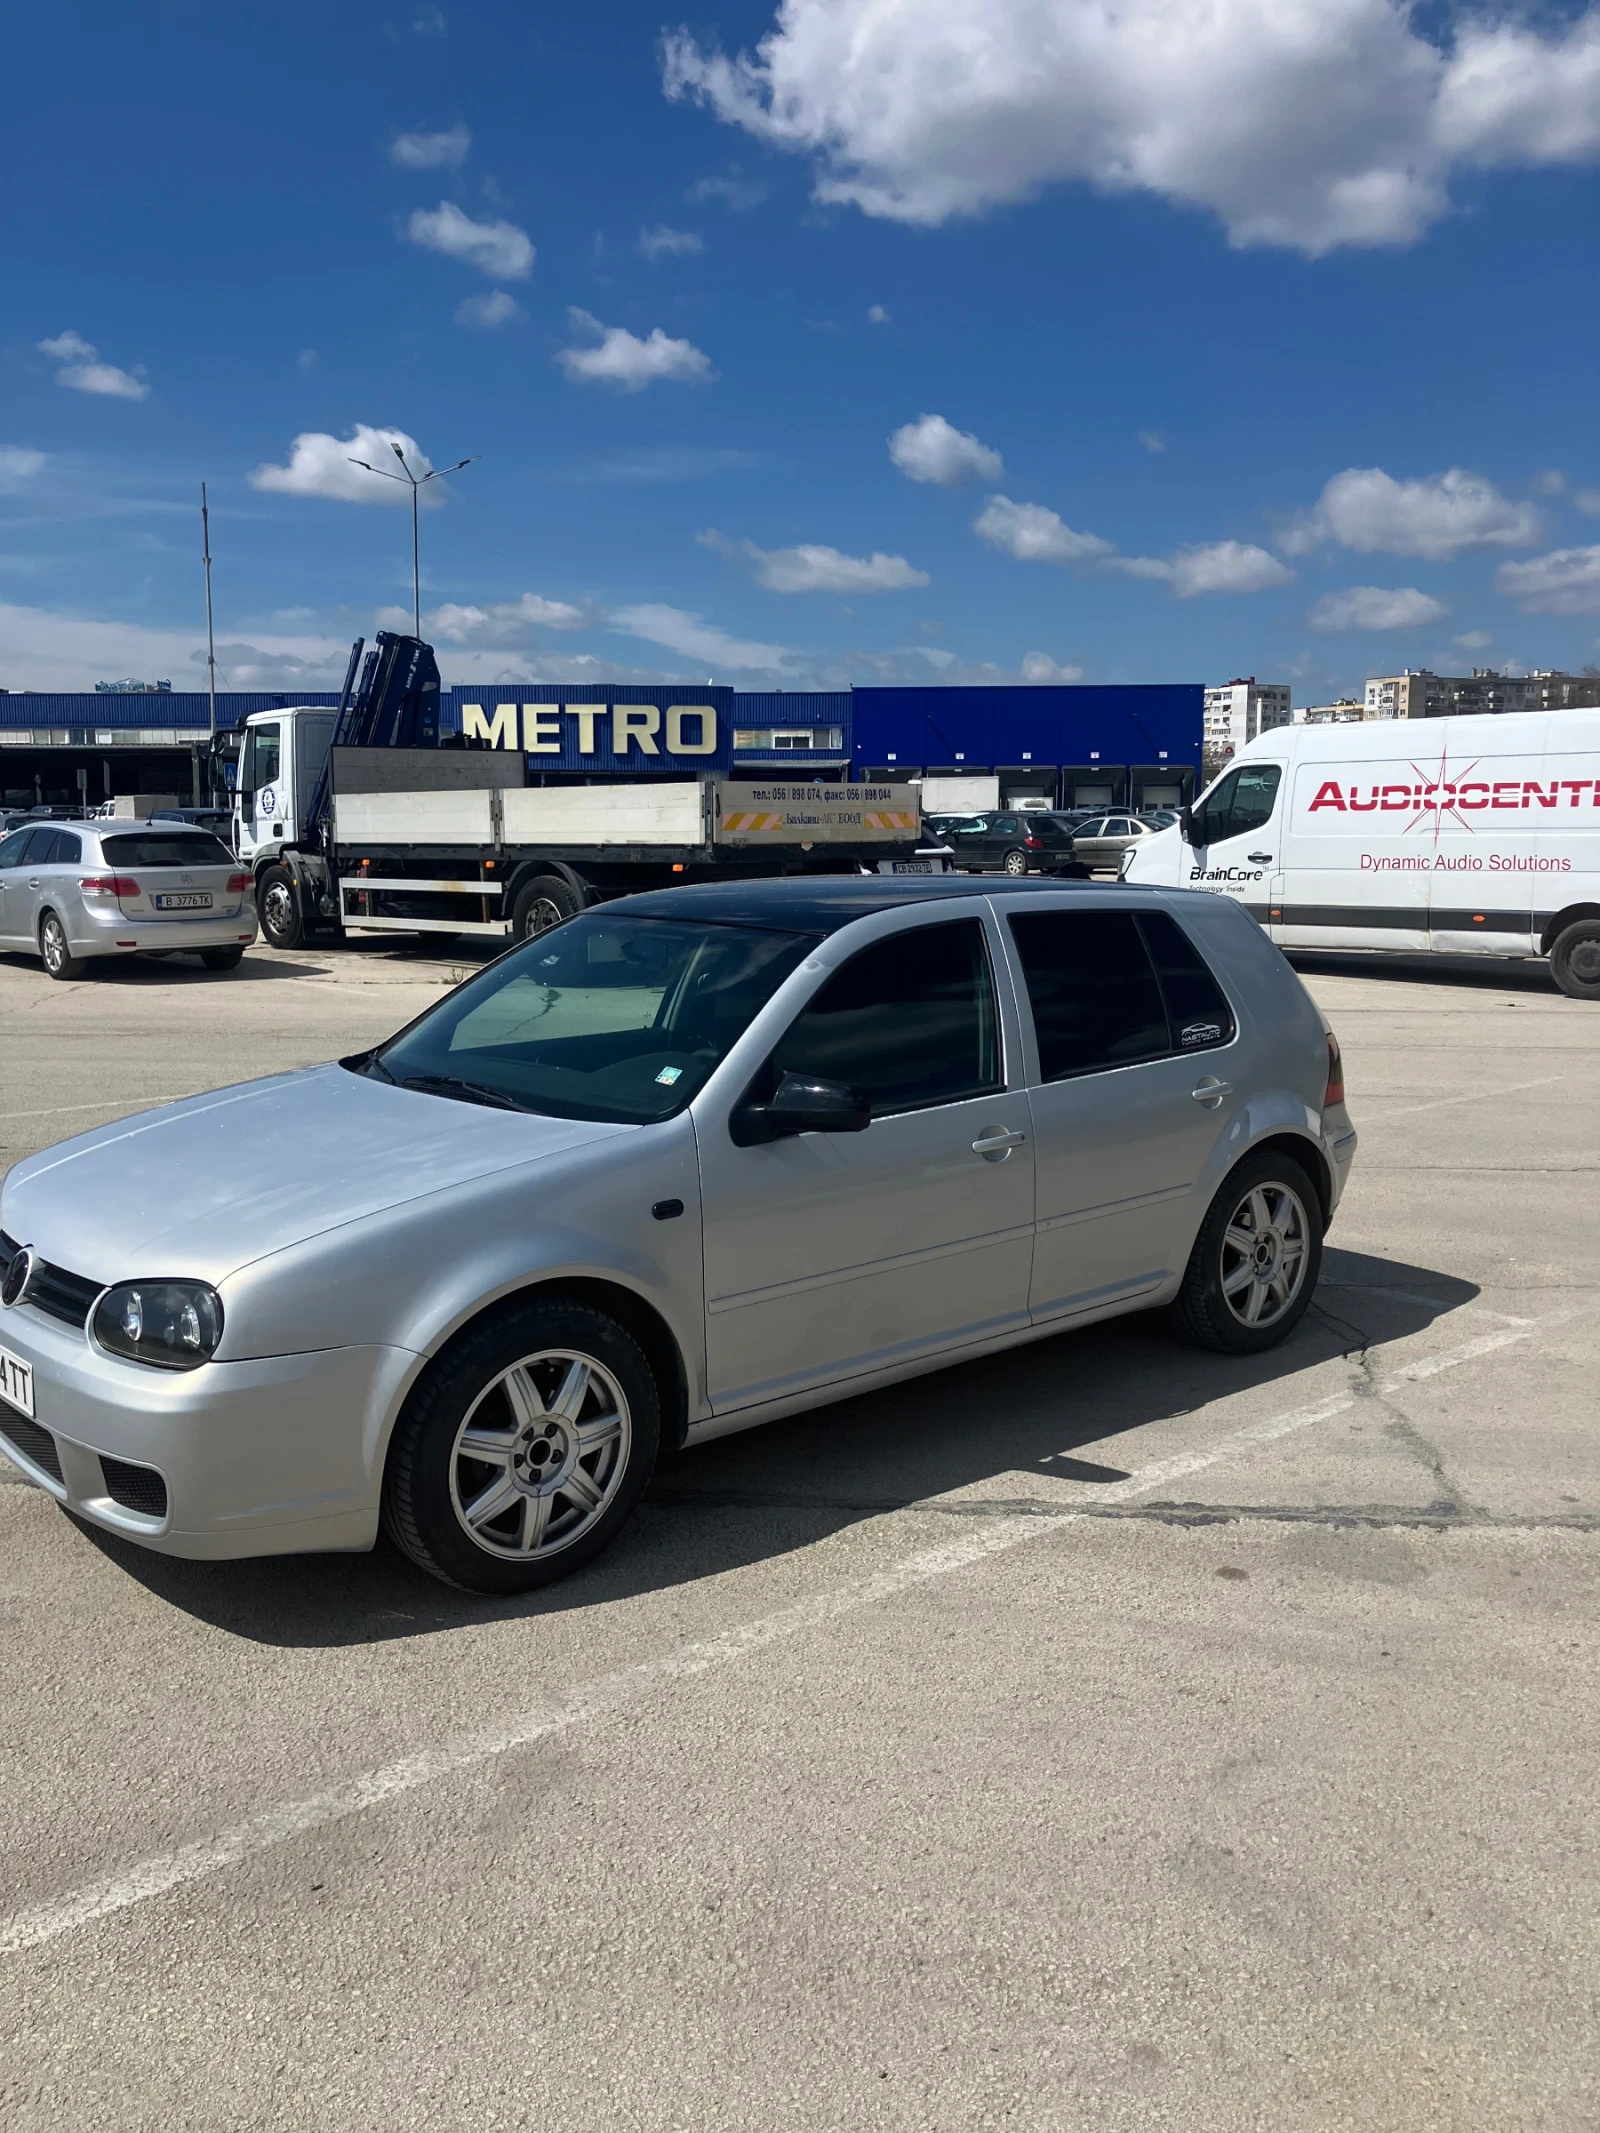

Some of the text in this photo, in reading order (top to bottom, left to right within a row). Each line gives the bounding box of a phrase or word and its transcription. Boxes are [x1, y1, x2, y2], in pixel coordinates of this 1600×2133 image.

[462, 703, 718, 756] METRO
[772, 787, 786, 801] 056
[791, 787, 805, 801] 898
[824, 788, 845, 803] факс:
[846, 788, 860, 801] 056
[864, 788, 877, 801] 898
[878, 788, 891, 801] 044
[1360, 853, 1572, 873] Dynamic Audio Solutions
[1189, 866, 1263, 881] BrainCore
[166, 895, 210, 906] B 3776 TK
